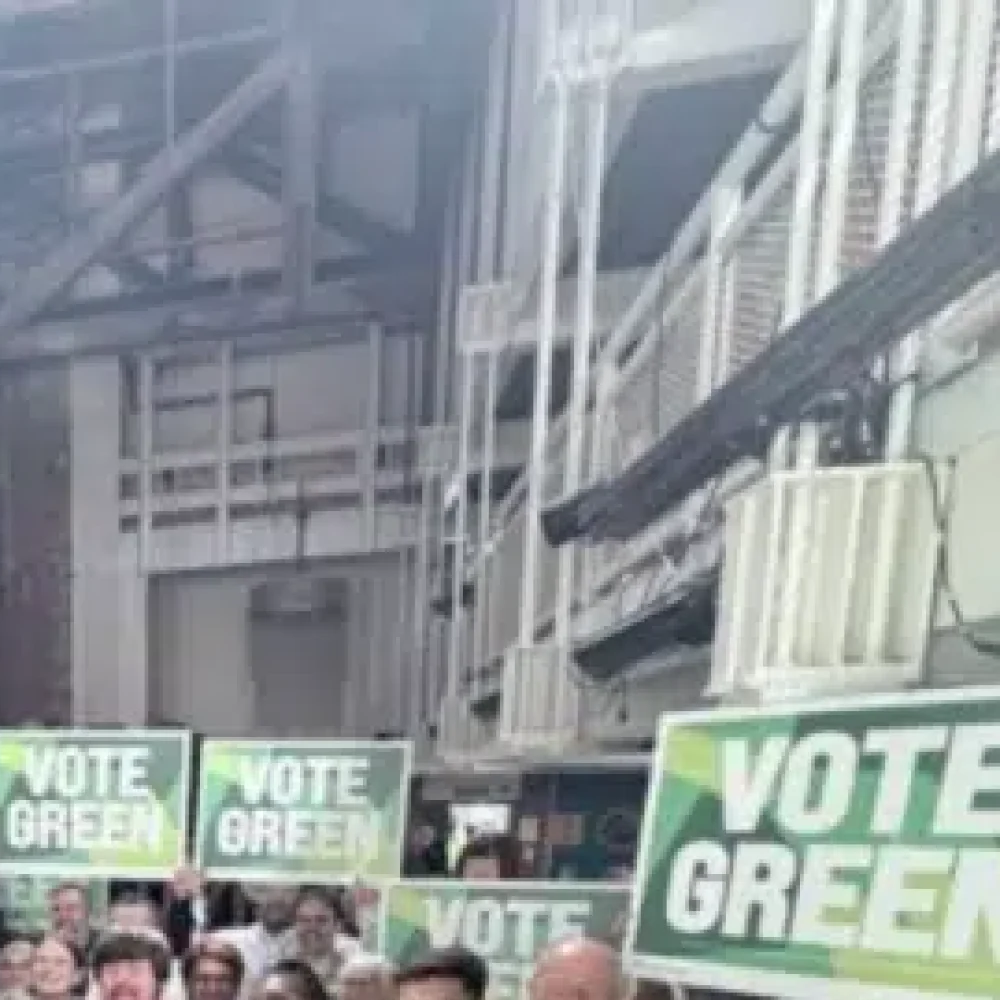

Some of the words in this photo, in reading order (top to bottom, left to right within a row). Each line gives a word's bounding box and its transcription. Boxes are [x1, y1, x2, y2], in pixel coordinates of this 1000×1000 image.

[24, 745, 149, 798] VOTE
[239, 756, 369, 805] VOTE
[722, 724, 1000, 835] VOTE
[7, 800, 164, 856] GREEN
[219, 808, 379, 860] GREEN
